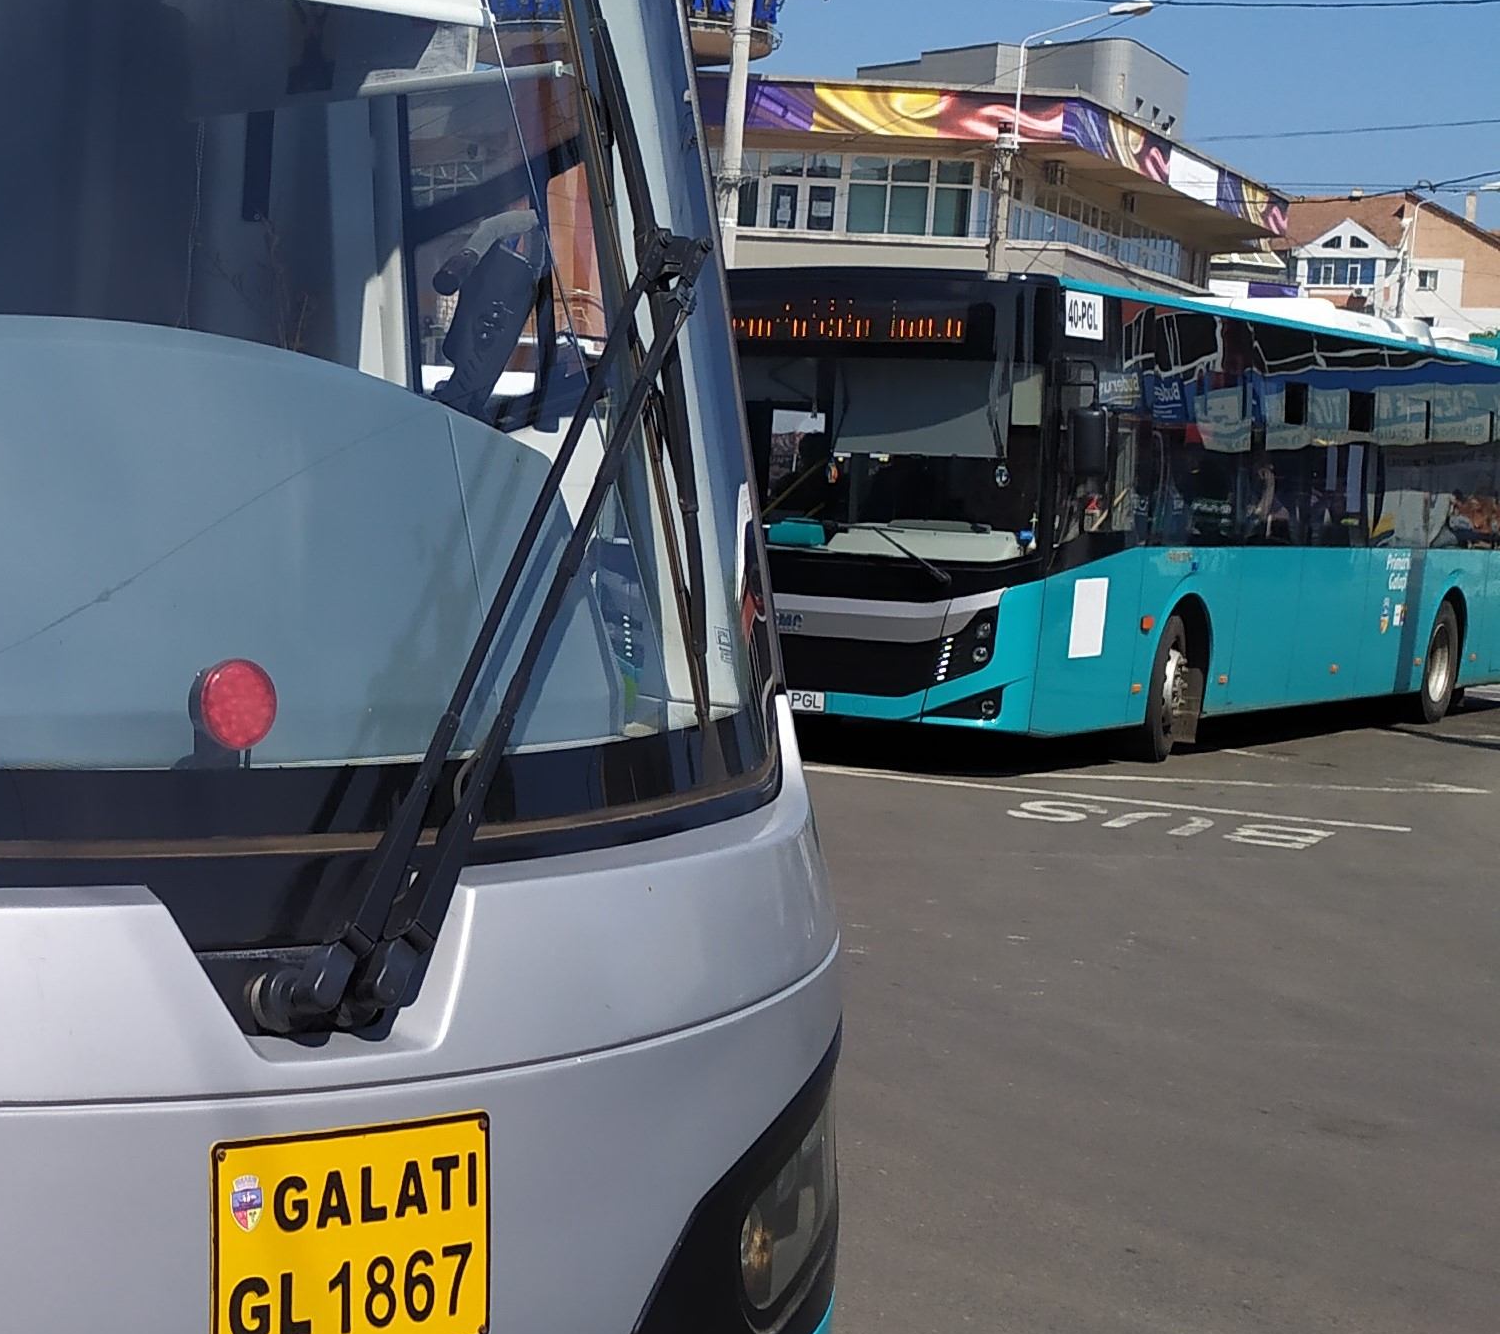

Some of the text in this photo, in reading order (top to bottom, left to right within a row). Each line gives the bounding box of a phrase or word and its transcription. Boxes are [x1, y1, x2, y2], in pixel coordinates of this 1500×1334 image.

[1068, 298, 1098, 330] 40-PGL
[776, 613, 804, 631] MC
[791, 692, 821, 709] PGL
[1006, 800, 1336, 849] BUS
[273, 1151, 477, 1233] GALATI
[328, 1242, 473, 1334] 1867
